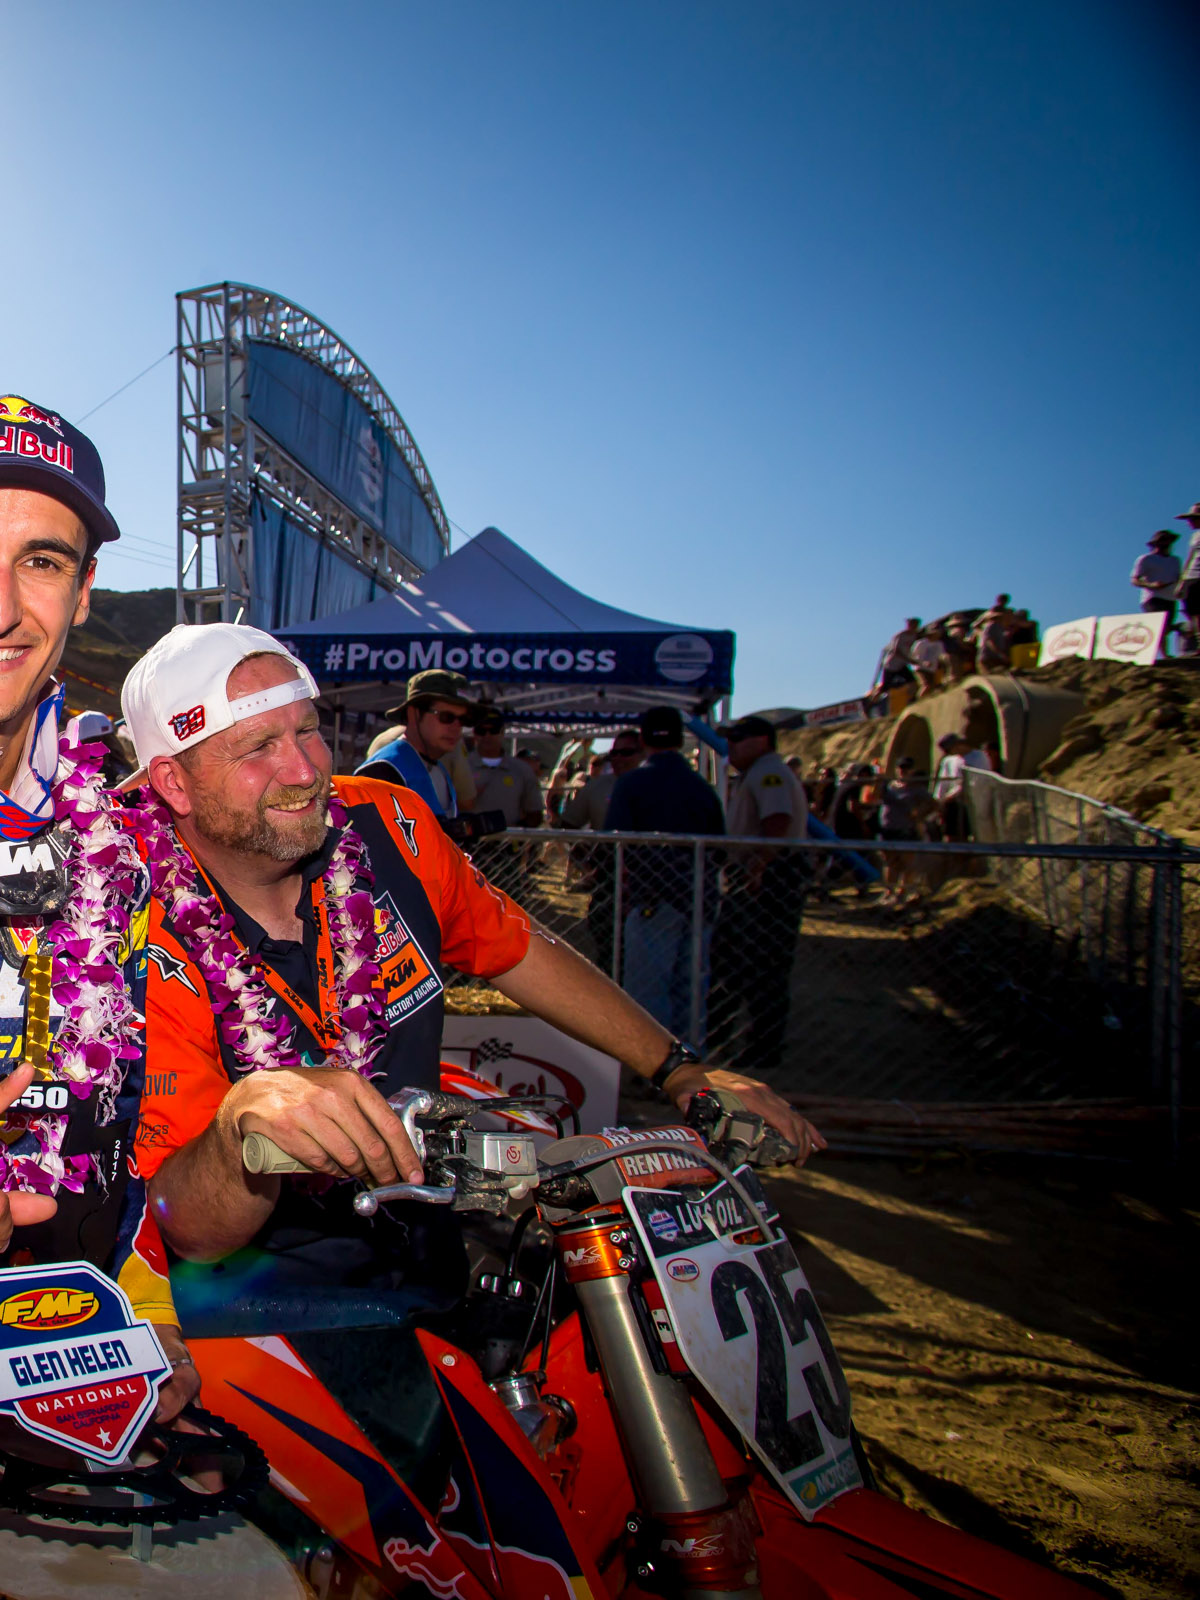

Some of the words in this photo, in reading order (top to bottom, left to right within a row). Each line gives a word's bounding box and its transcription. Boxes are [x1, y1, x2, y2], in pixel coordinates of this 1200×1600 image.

[17, 428, 74, 474] Bull
[324, 640, 617, 674] #ProMotocross
[384, 957, 418, 993] KTM
[414, 977, 438, 1002] RACING
[7, 1086, 69, 1109] 50
[622, 1151, 700, 1177] RENTHA
[716, 1197, 743, 1228] OIL
[1, 1291, 94, 1325] FMF
[8, 1350, 69, 1387] GLEN
[63, 1339, 133, 1377] HELEN
[711, 1239, 852, 1474] 25
[36, 1383, 137, 1414] NATIONAL
[55, 1412, 76, 1424] SAN
